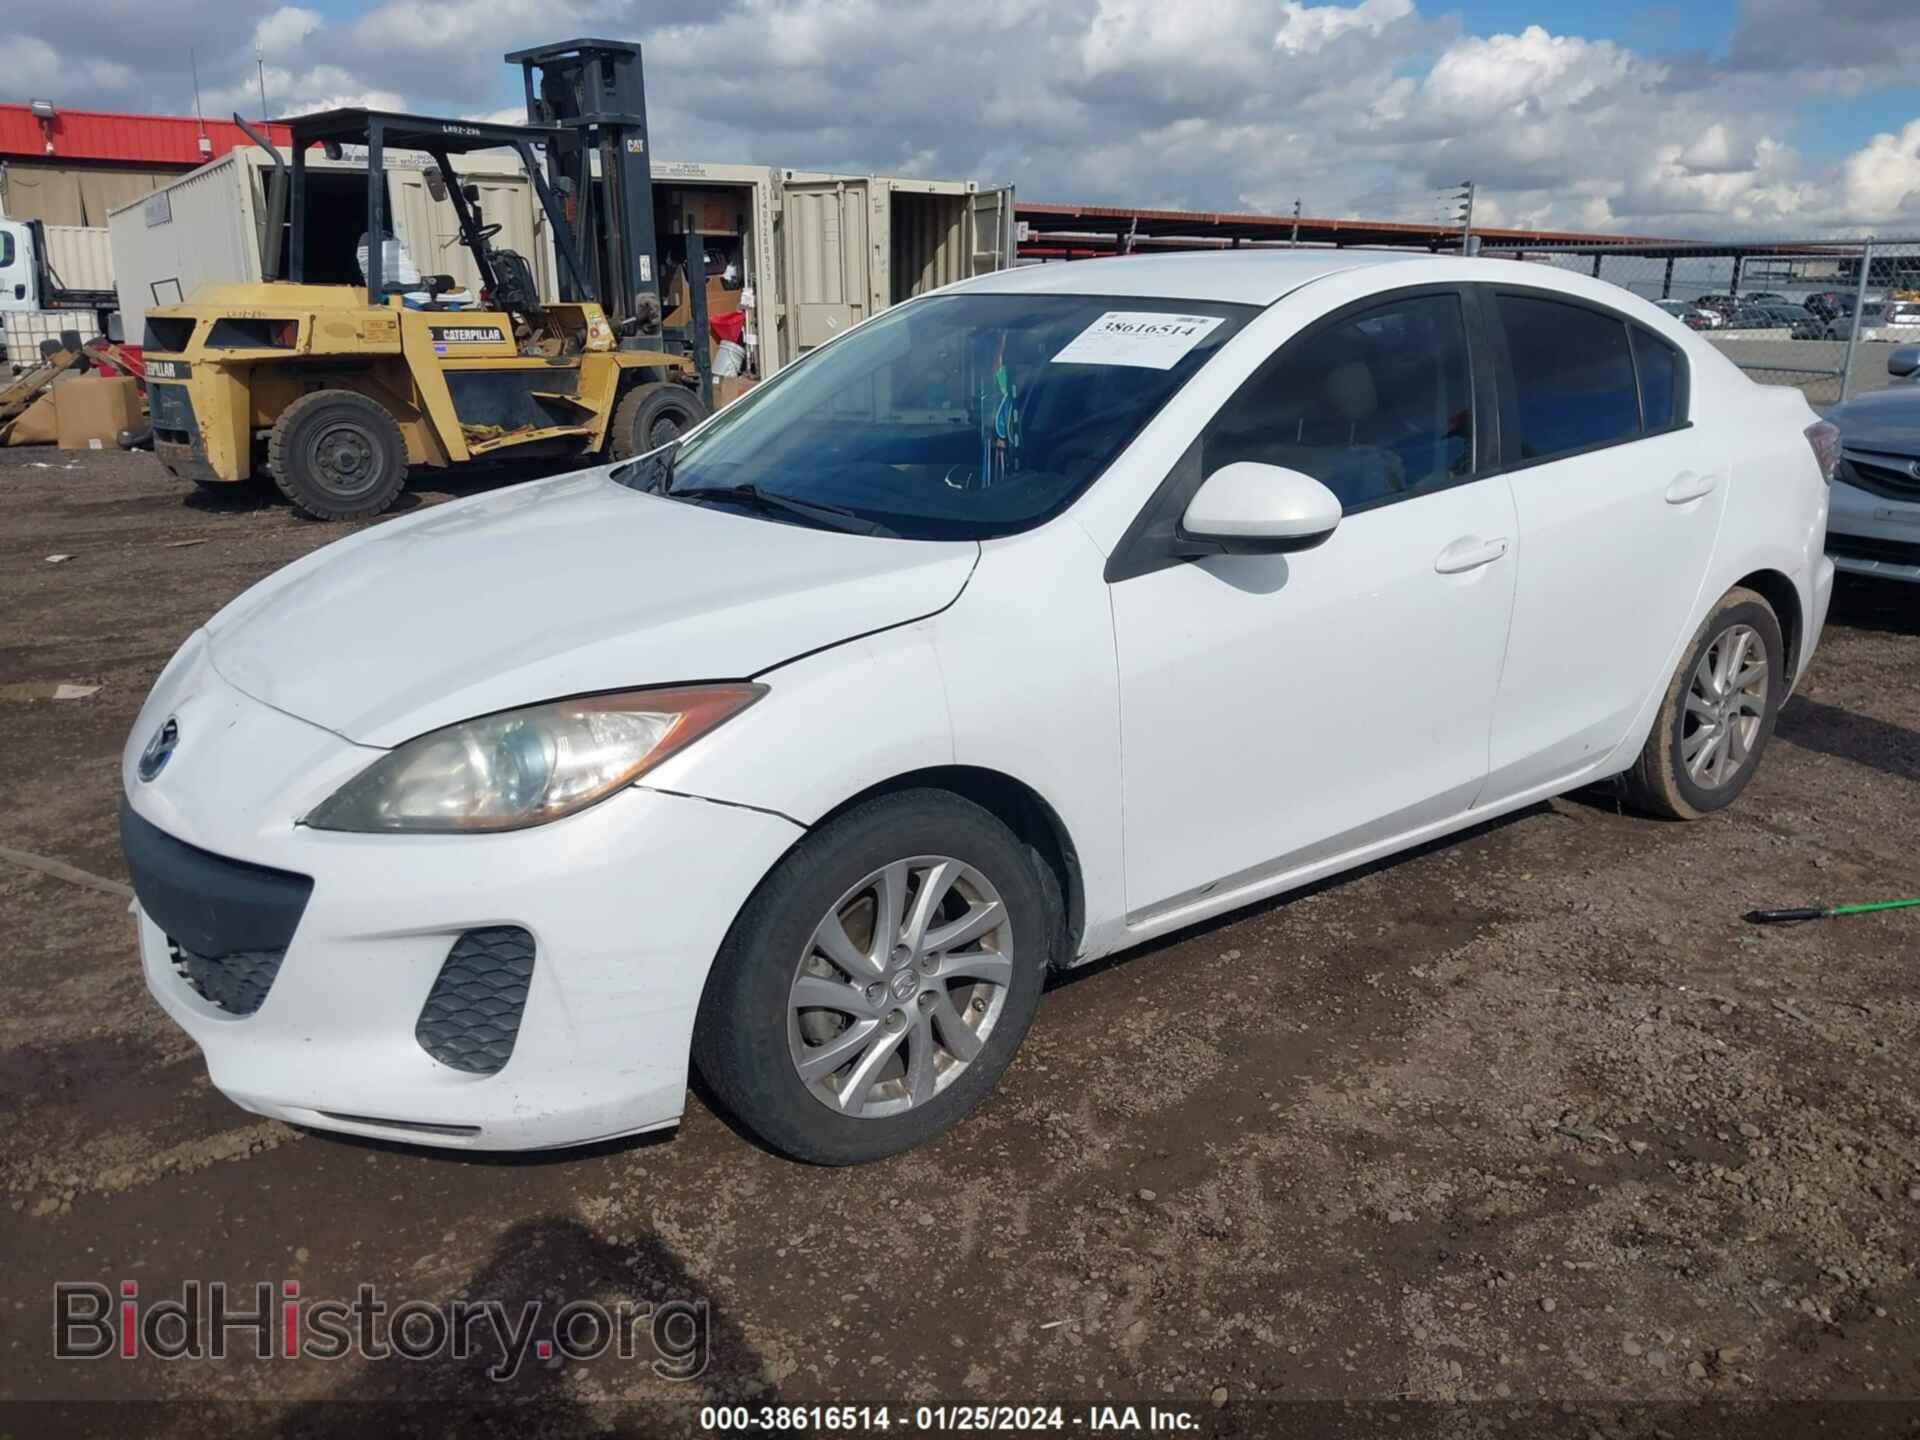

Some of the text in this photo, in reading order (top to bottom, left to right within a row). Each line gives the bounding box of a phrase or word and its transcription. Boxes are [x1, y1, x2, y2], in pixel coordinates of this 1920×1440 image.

[627, 139, 643, 152] CAT
[443, 329, 500, 340] CATERPILLAR
[1098, 320, 1197, 336] 38616514
